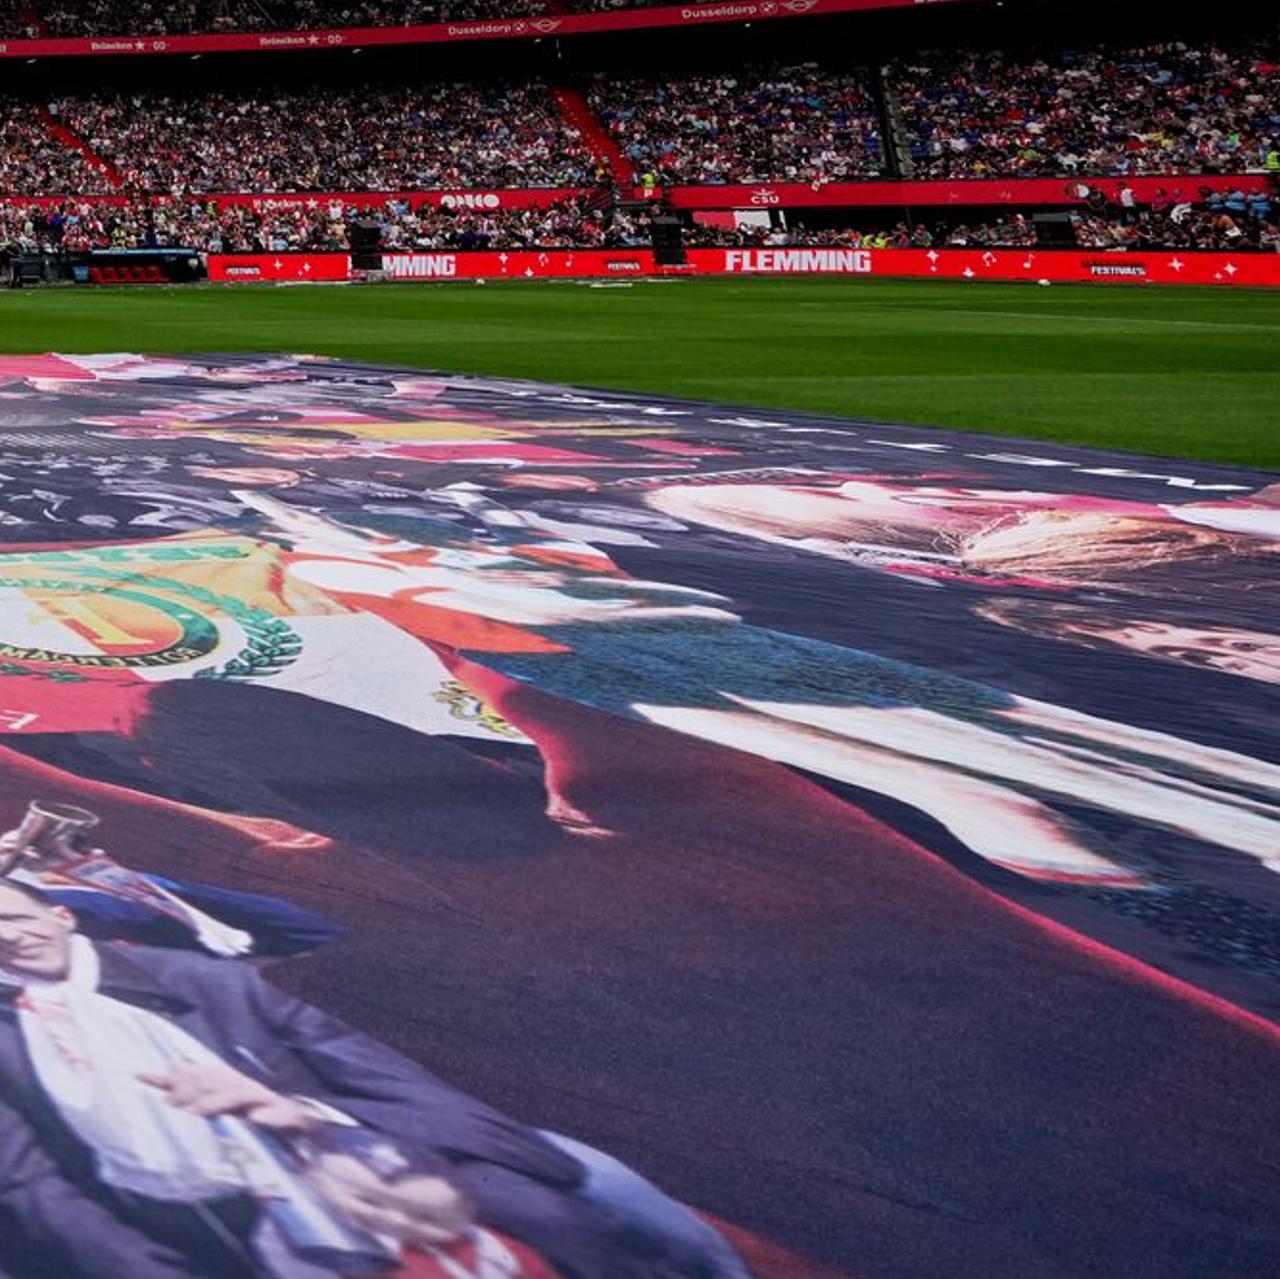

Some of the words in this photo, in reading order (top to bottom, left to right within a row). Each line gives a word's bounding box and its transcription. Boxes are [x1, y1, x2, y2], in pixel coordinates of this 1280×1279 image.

[681, 5, 757, 19] Dusseldorp
[448, 23, 511, 36] Dusseldorp
[382, 255, 456, 276] MMING
[725, 250, 871, 272] FLEMMING
